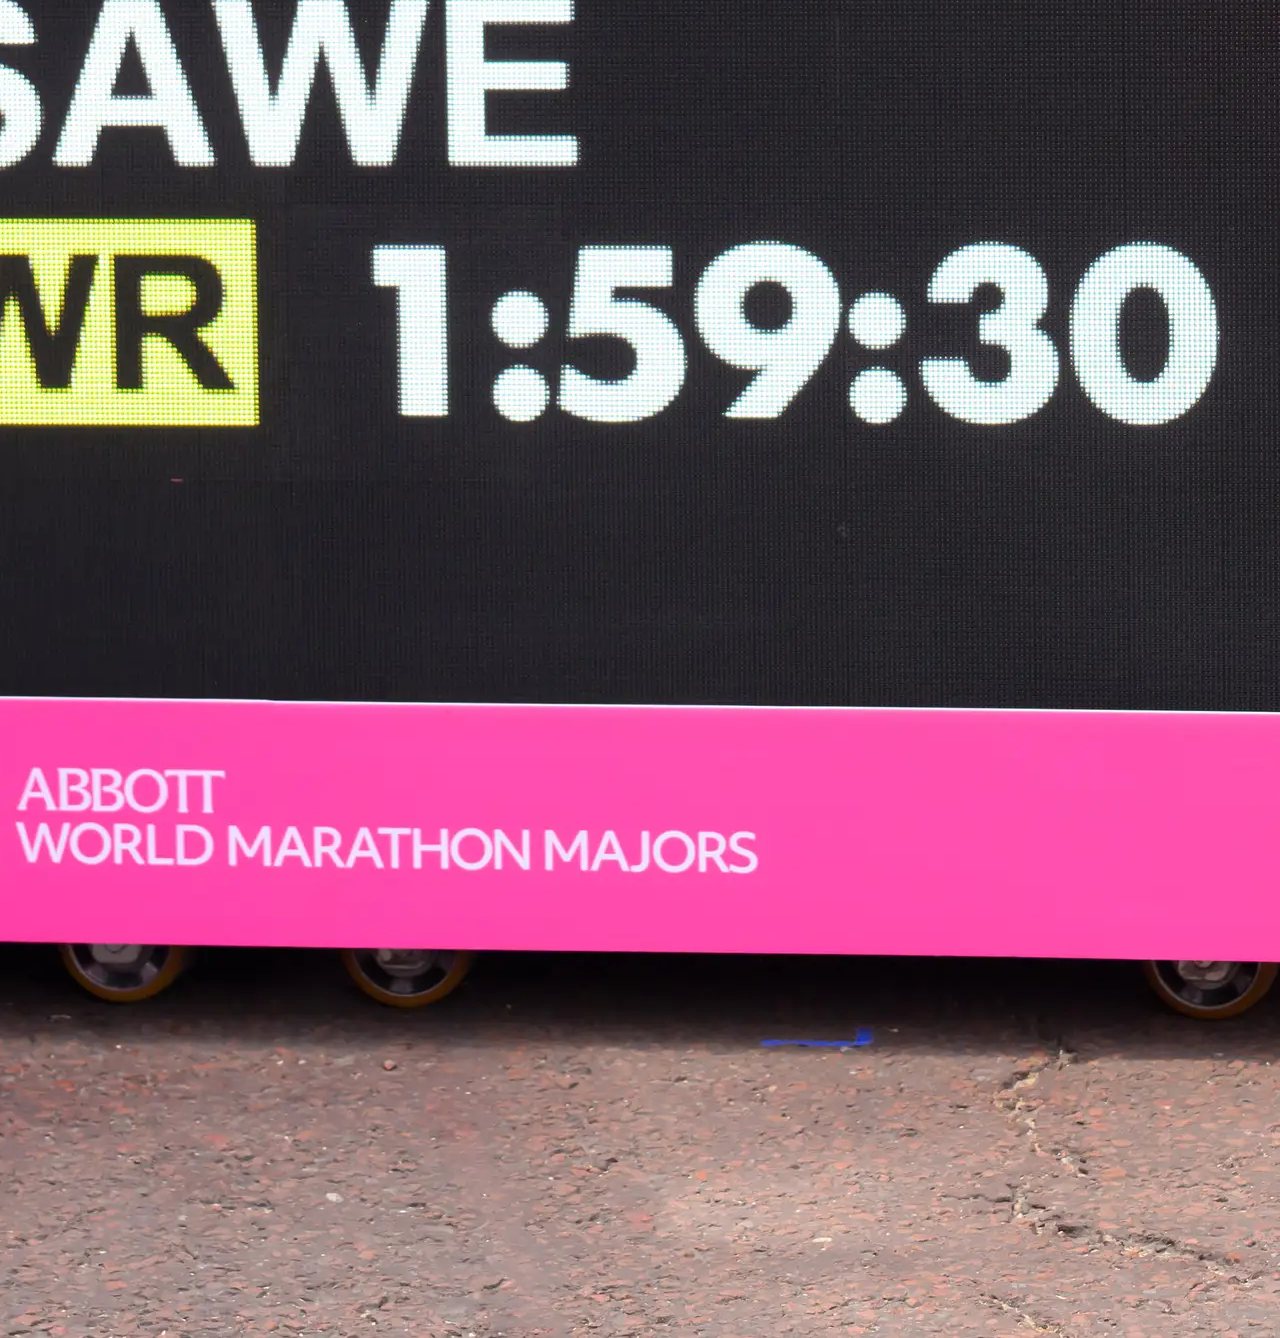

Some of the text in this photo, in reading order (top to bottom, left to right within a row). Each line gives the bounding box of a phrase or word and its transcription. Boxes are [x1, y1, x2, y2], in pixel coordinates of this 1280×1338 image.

[373, 240, 1221, 425] 1:59:30
[18, 767, 226, 814] ABBOTT
[16, 822, 758, 874] WORLD MARATHON MAJORS
